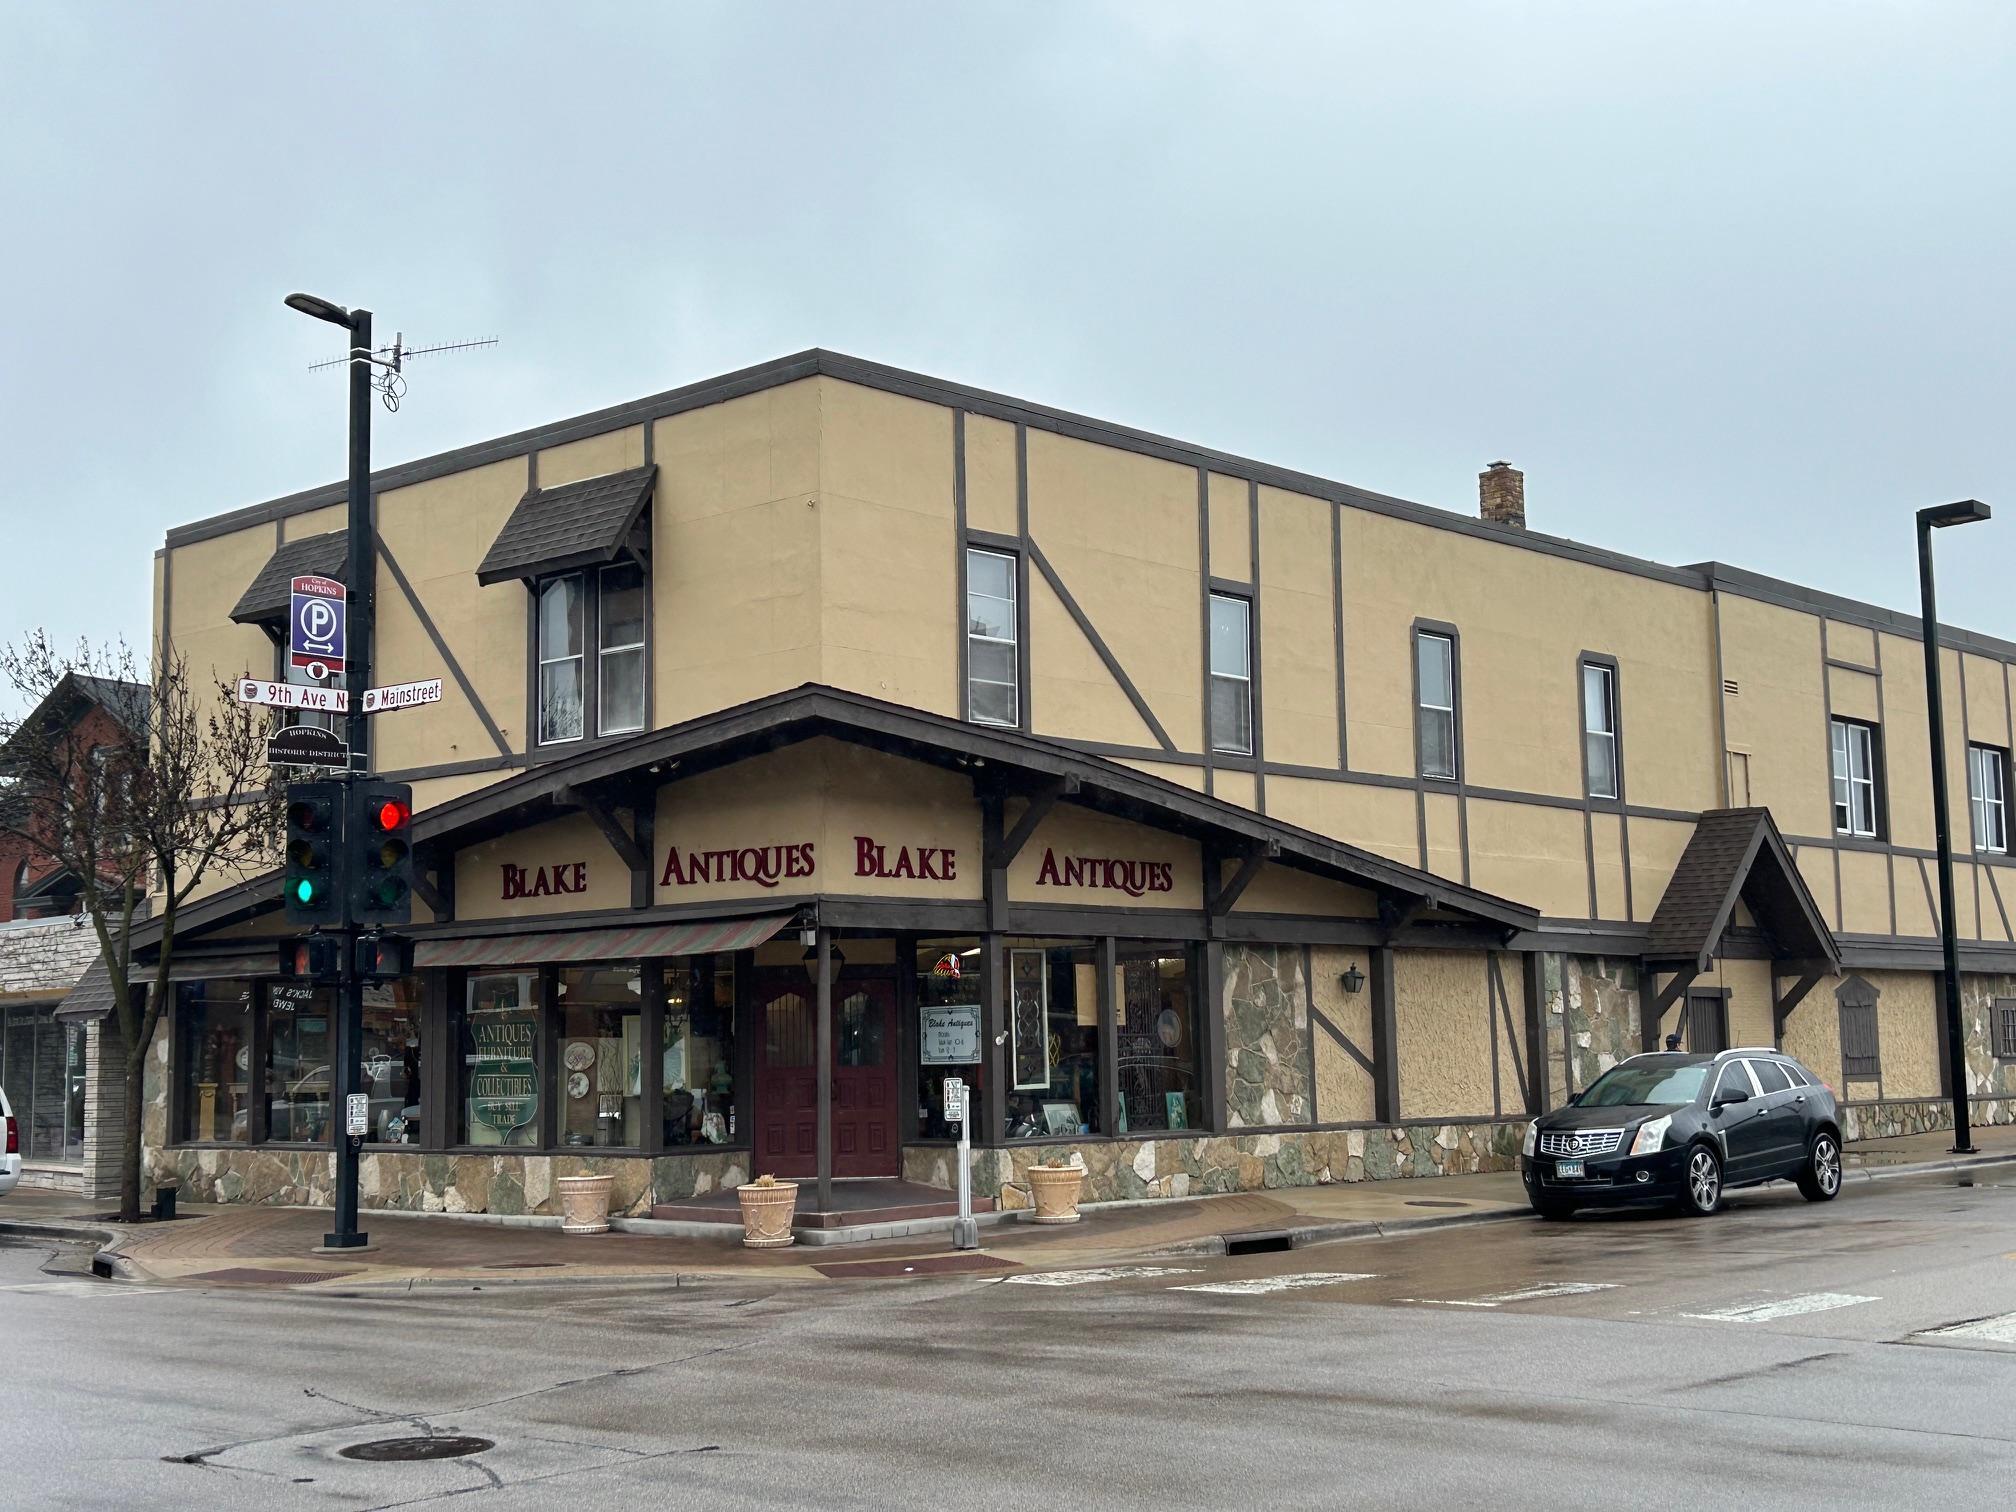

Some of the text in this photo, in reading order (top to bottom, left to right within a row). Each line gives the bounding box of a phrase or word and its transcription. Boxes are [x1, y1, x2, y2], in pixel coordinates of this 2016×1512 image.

[301, 583, 337, 595] HOPKINS
[311, 605, 329, 635] P
[268, 685, 345, 709] 9th Ave N
[381, 682, 439, 706] Mainstreet
[289, 729, 327, 739] HOPKINS
[269, 747, 347, 758] HISTORIC DISTRICT
[501, 842, 815, 900] BLAKE ANTIQUES
[854, 836, 1173, 897] BLAKE ANTIQUES
[479, 1024, 532, 1046] ANTIQUES
[478, 1046, 532, 1060] FURNITURE
[500, 1062, 508, 1073] &
[476, 1078, 532, 1097] COLLECTIBLES
[493, 1114, 516, 1125] TRADE
